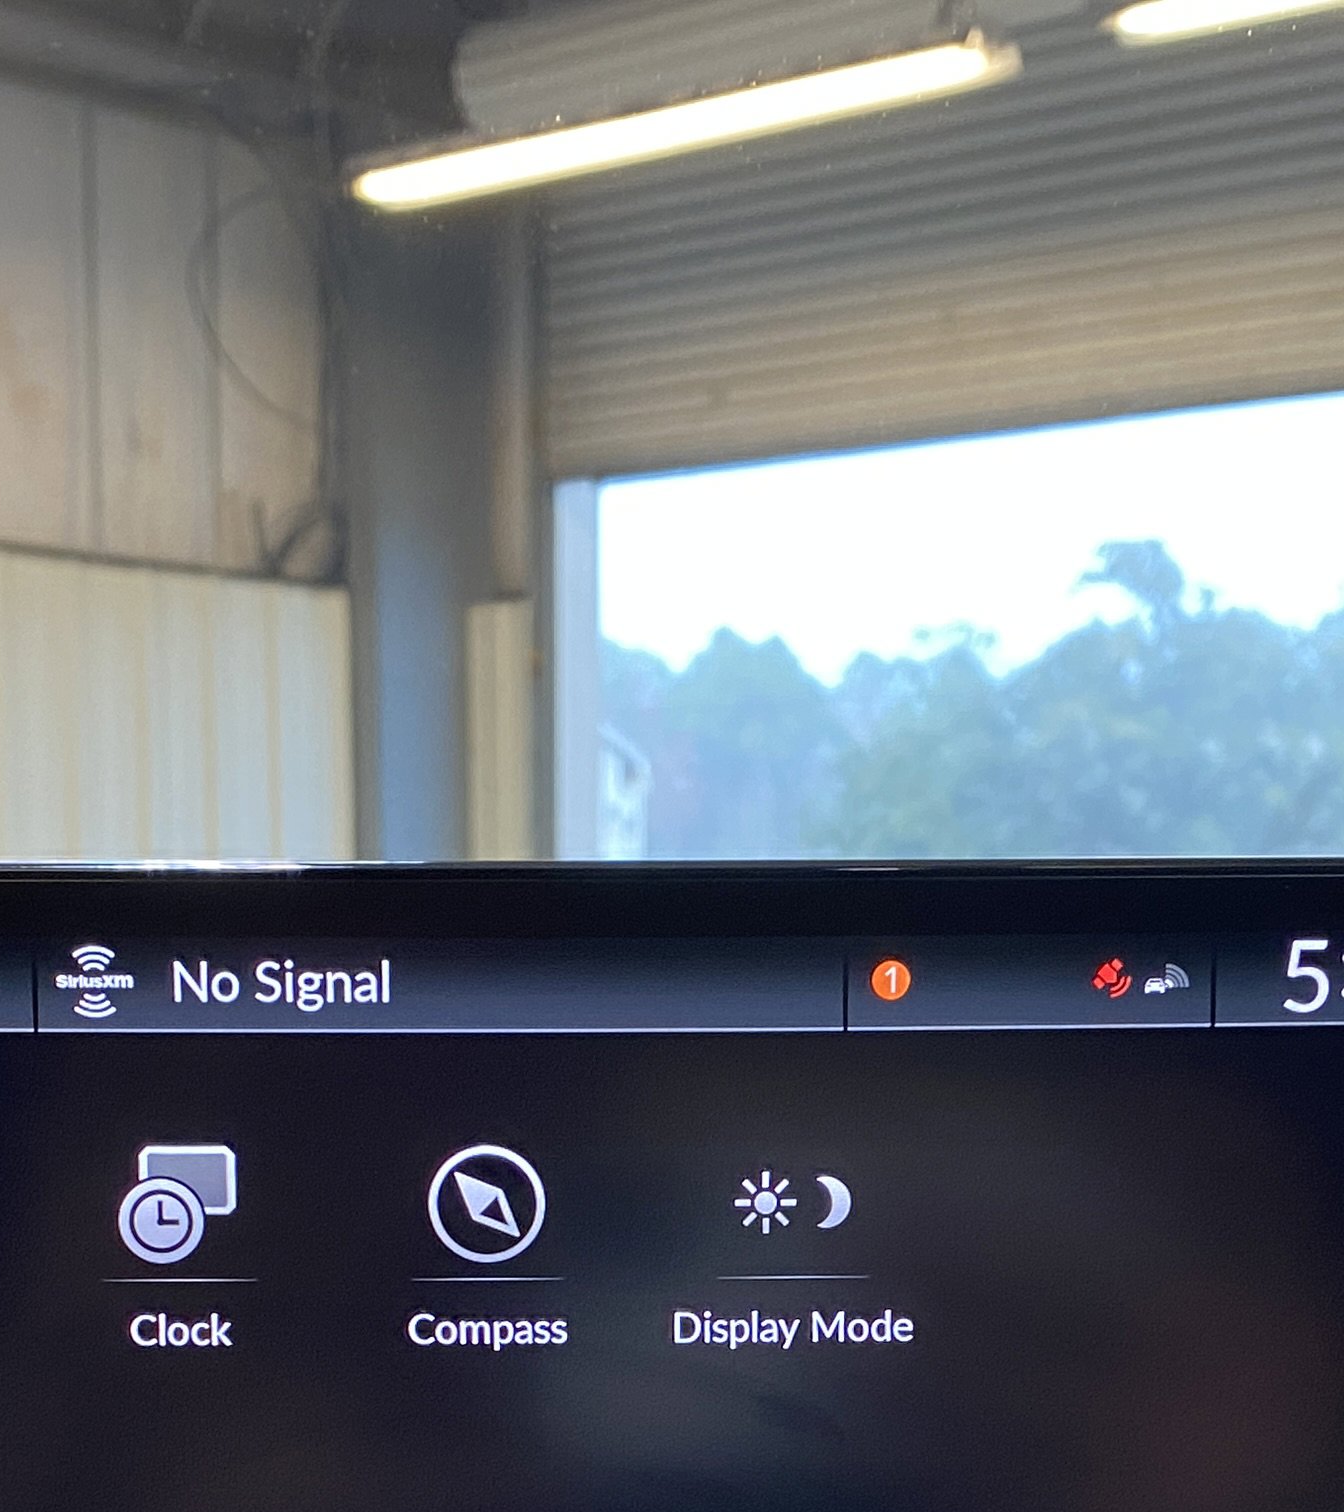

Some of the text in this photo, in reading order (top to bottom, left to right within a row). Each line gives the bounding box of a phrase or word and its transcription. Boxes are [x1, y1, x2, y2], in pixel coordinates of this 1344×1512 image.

[172, 958, 390, 1013] No Signal
[884, 966, 897, 994] 1
[129, 1312, 233, 1347] Clock
[407, 1313, 568, 1352] Compass
[673, 1309, 914, 1350] Display Mode
